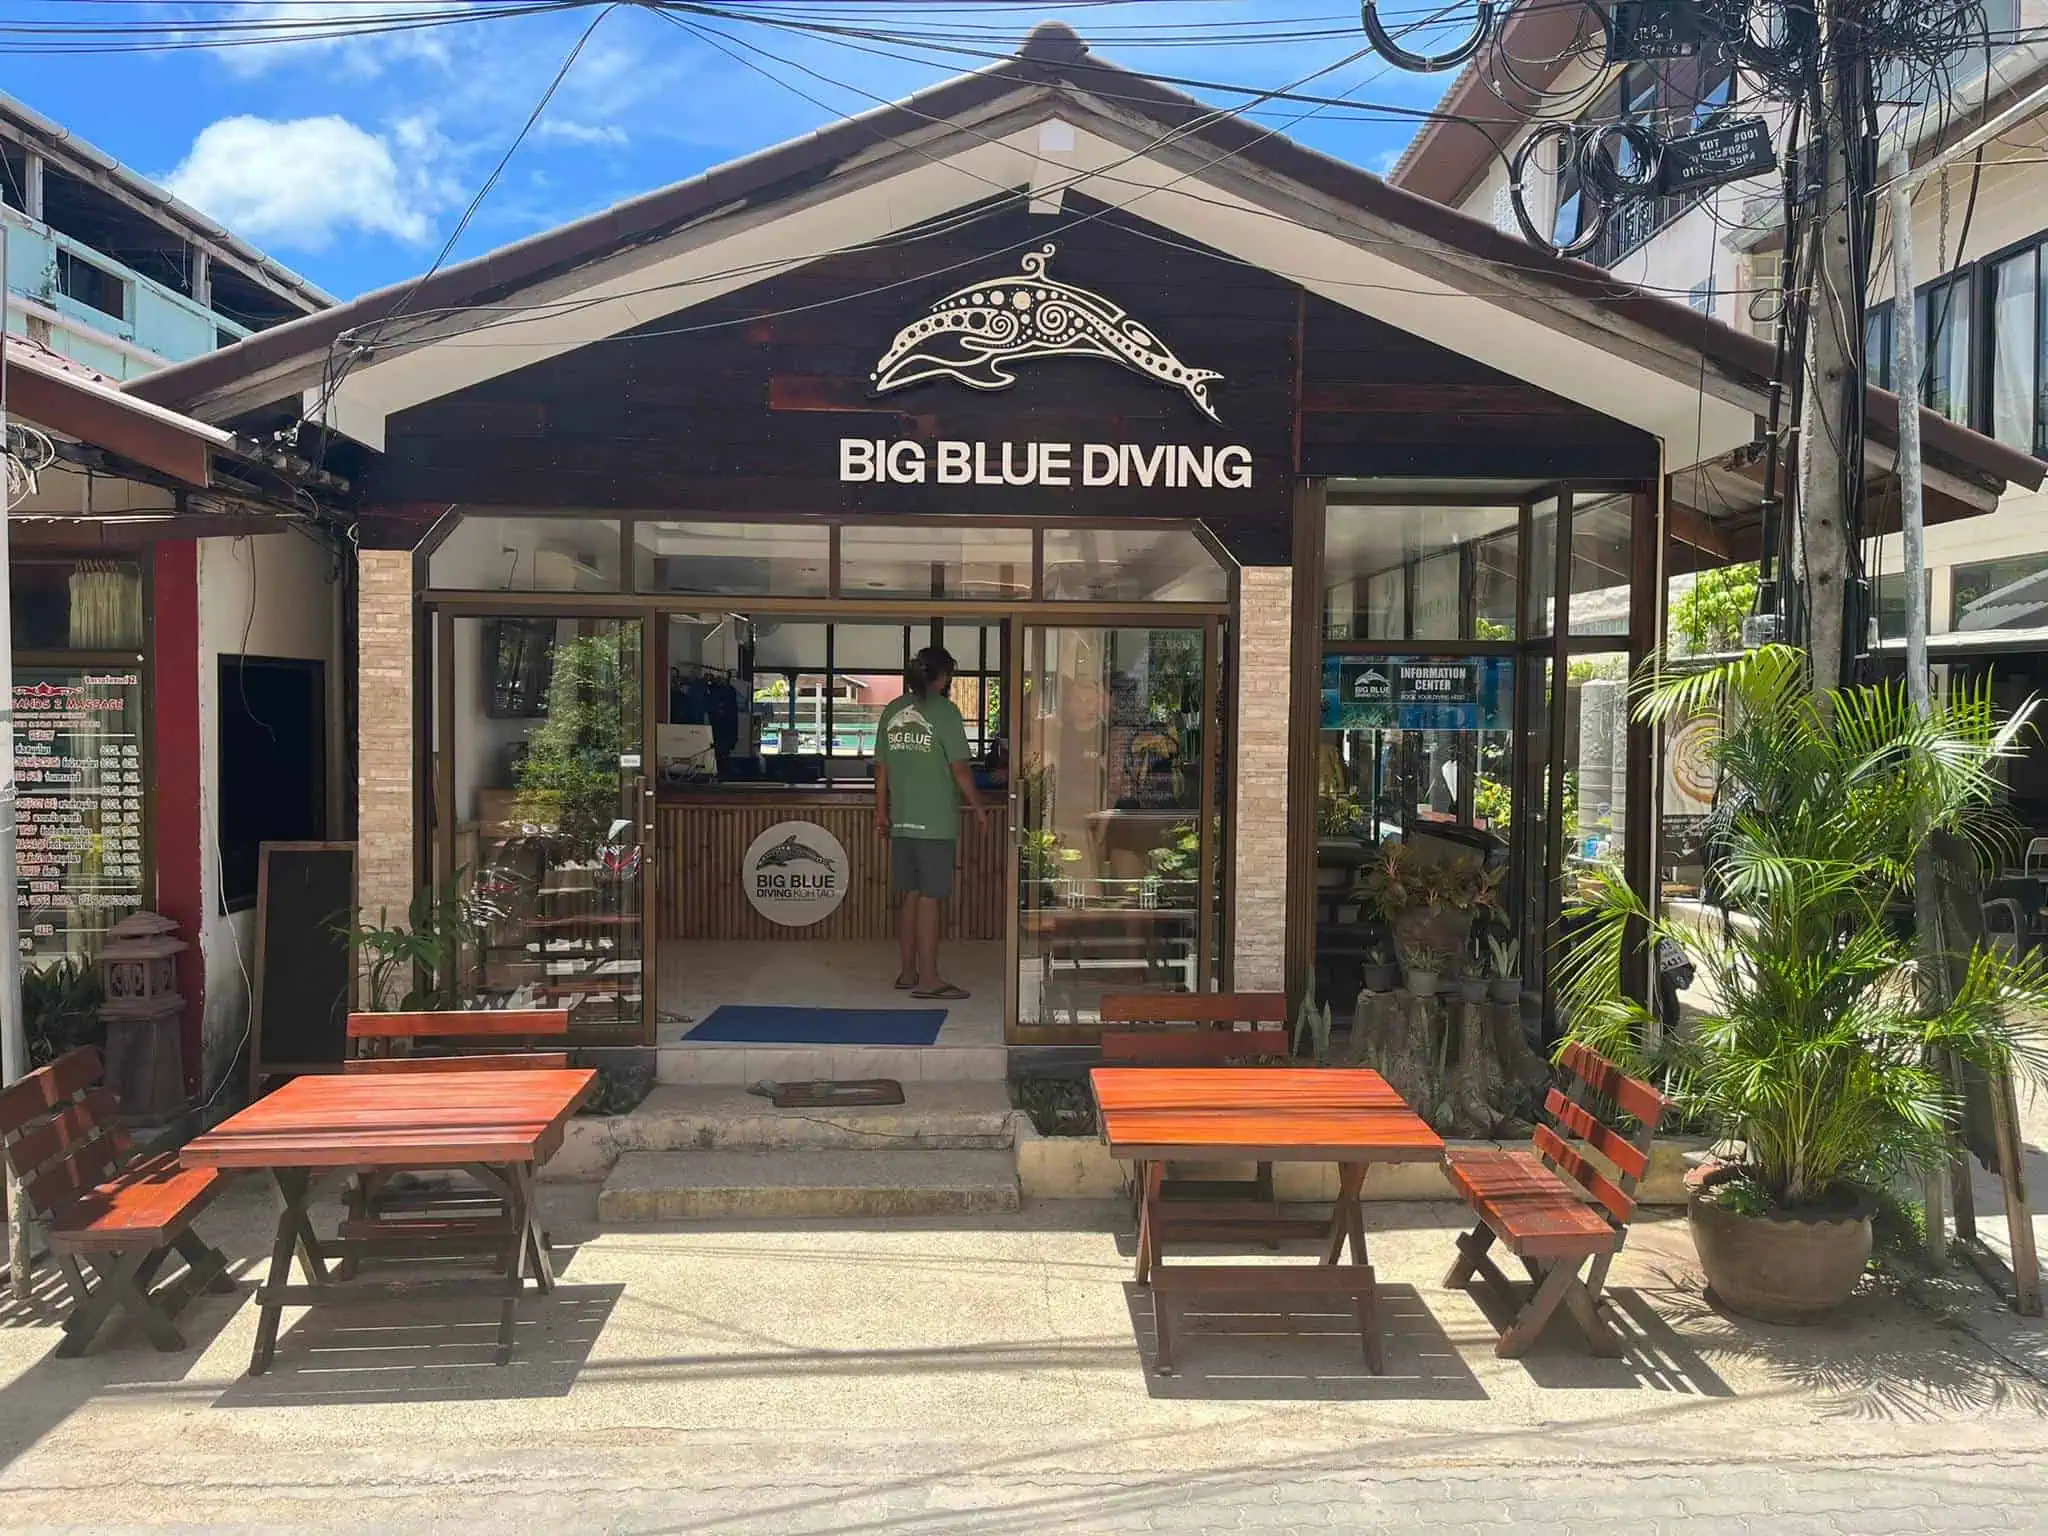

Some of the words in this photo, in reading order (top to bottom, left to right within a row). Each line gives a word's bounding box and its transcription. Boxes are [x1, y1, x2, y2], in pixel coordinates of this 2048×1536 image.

[838, 438, 926, 484] BIG
[937, 440, 1072, 486] BLUE
[1082, 443, 1253, 489] DIVING
[1400, 667, 1466, 679] INFORMATION
[1415, 679, 1452, 691] CENTER
[66, 696, 124, 711] MASSAGE
[888, 732, 903, 744] BIG
[904, 732, 932, 746] BLUE
[756, 874, 785, 888] BIG
[791, 874, 835, 889] BLUE
[756, 889, 792, 898] DIVING
